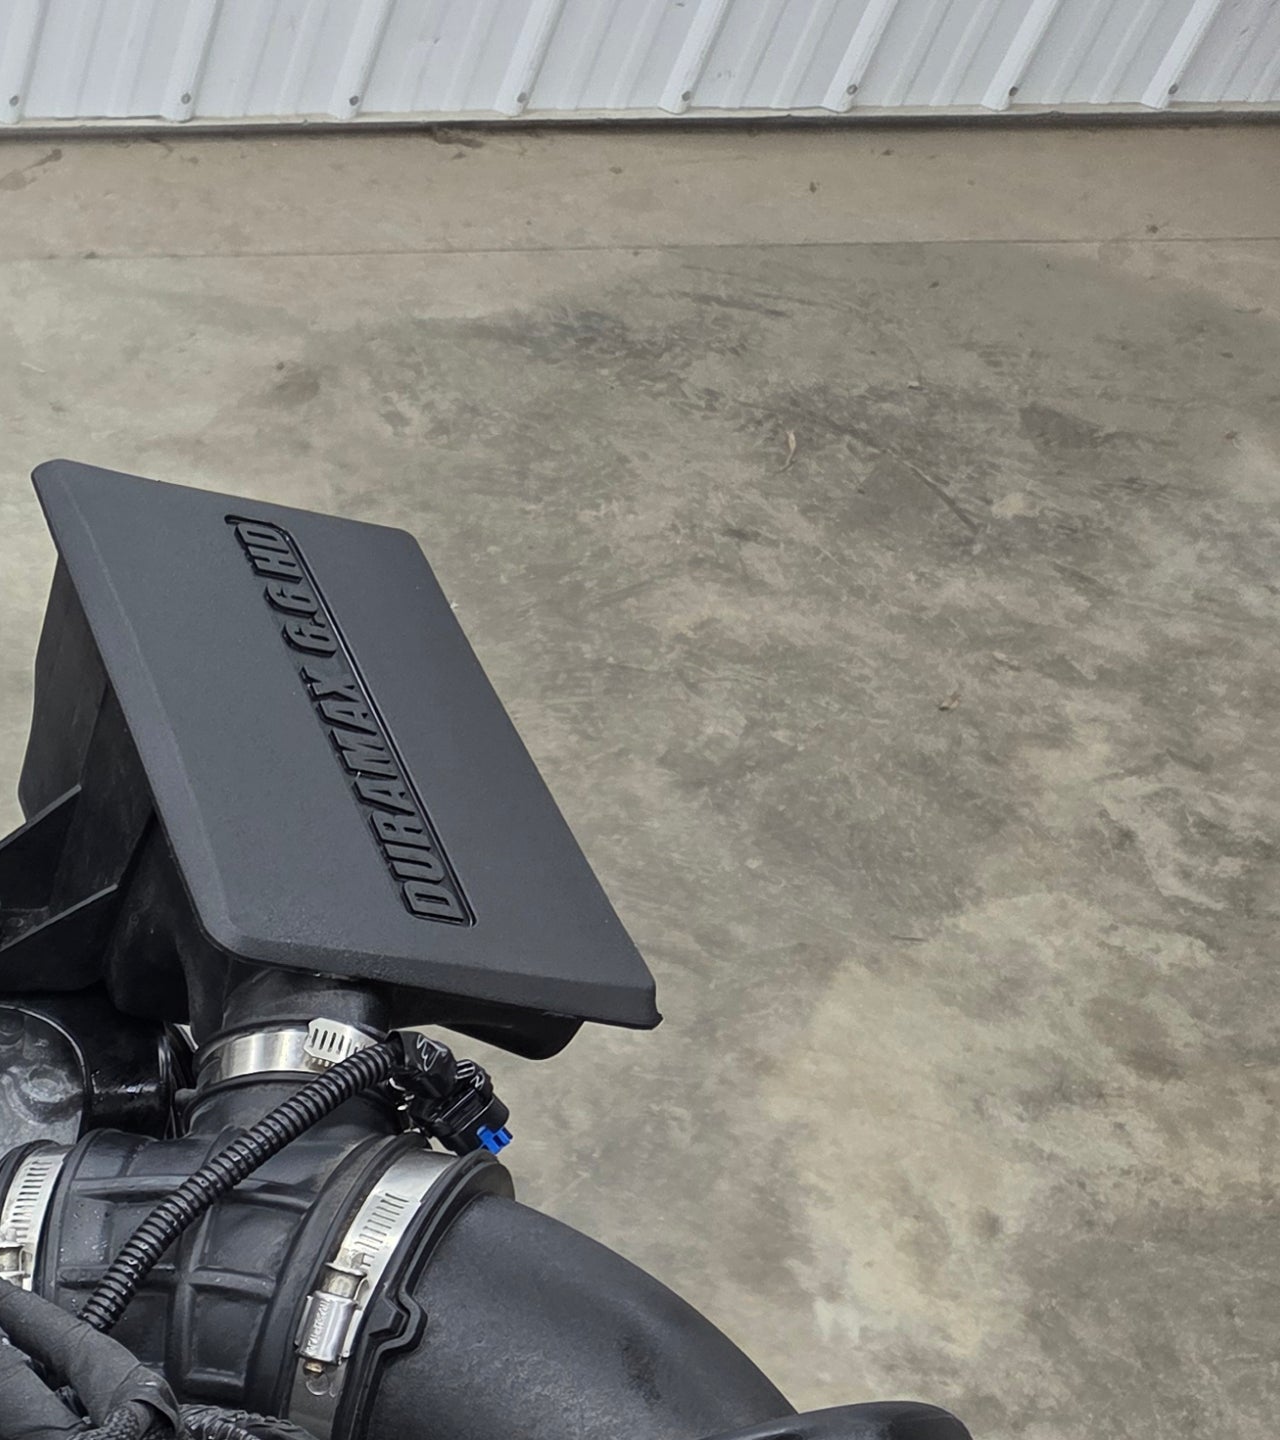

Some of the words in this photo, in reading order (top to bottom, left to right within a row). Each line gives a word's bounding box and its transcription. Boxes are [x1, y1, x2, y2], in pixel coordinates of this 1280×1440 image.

[234, 522, 303, 584] HD
[264, 586, 339, 658] 6.6
[299, 667, 467, 925] DURAMAX
